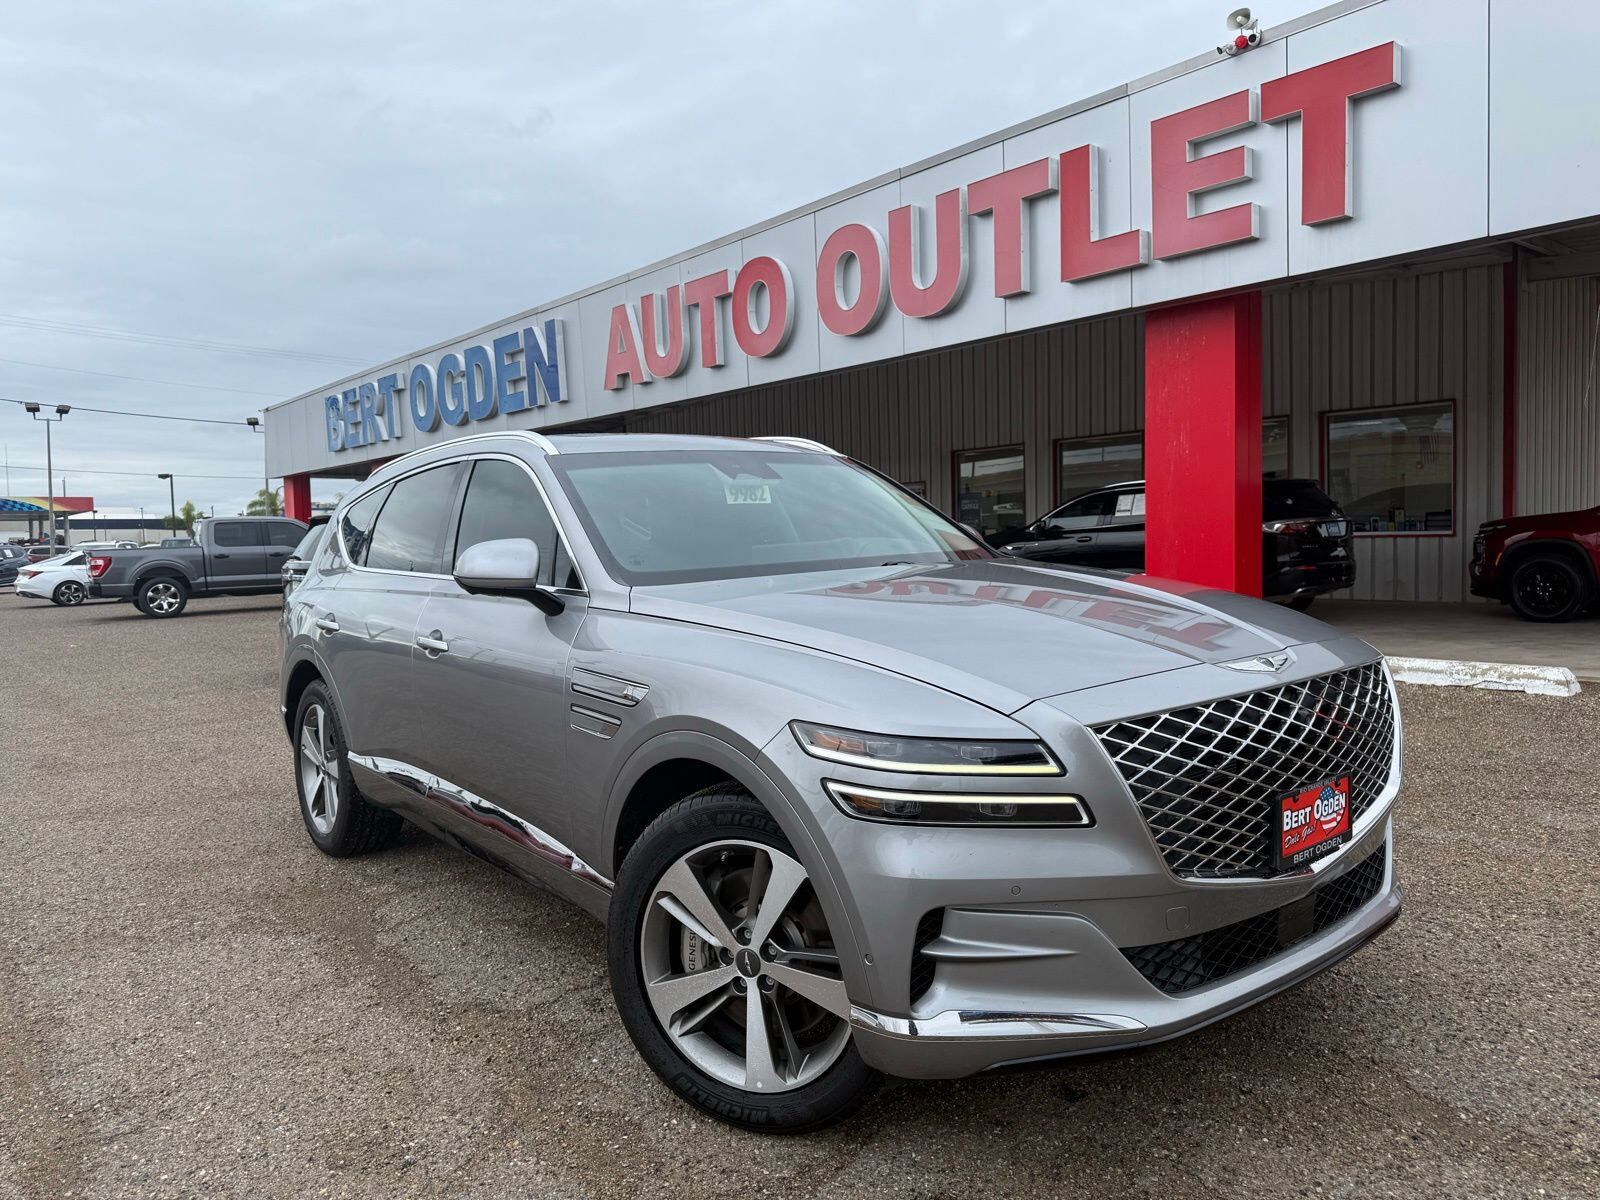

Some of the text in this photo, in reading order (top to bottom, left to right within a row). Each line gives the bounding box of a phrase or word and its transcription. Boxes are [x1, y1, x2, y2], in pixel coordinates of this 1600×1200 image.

[325, 41, 1402, 452] BERT OGDEN AUTO OUTLET
[1283, 792, 1346, 831] BERT OGDEN
[1293, 836, 1342, 864] BERT OGDEN
